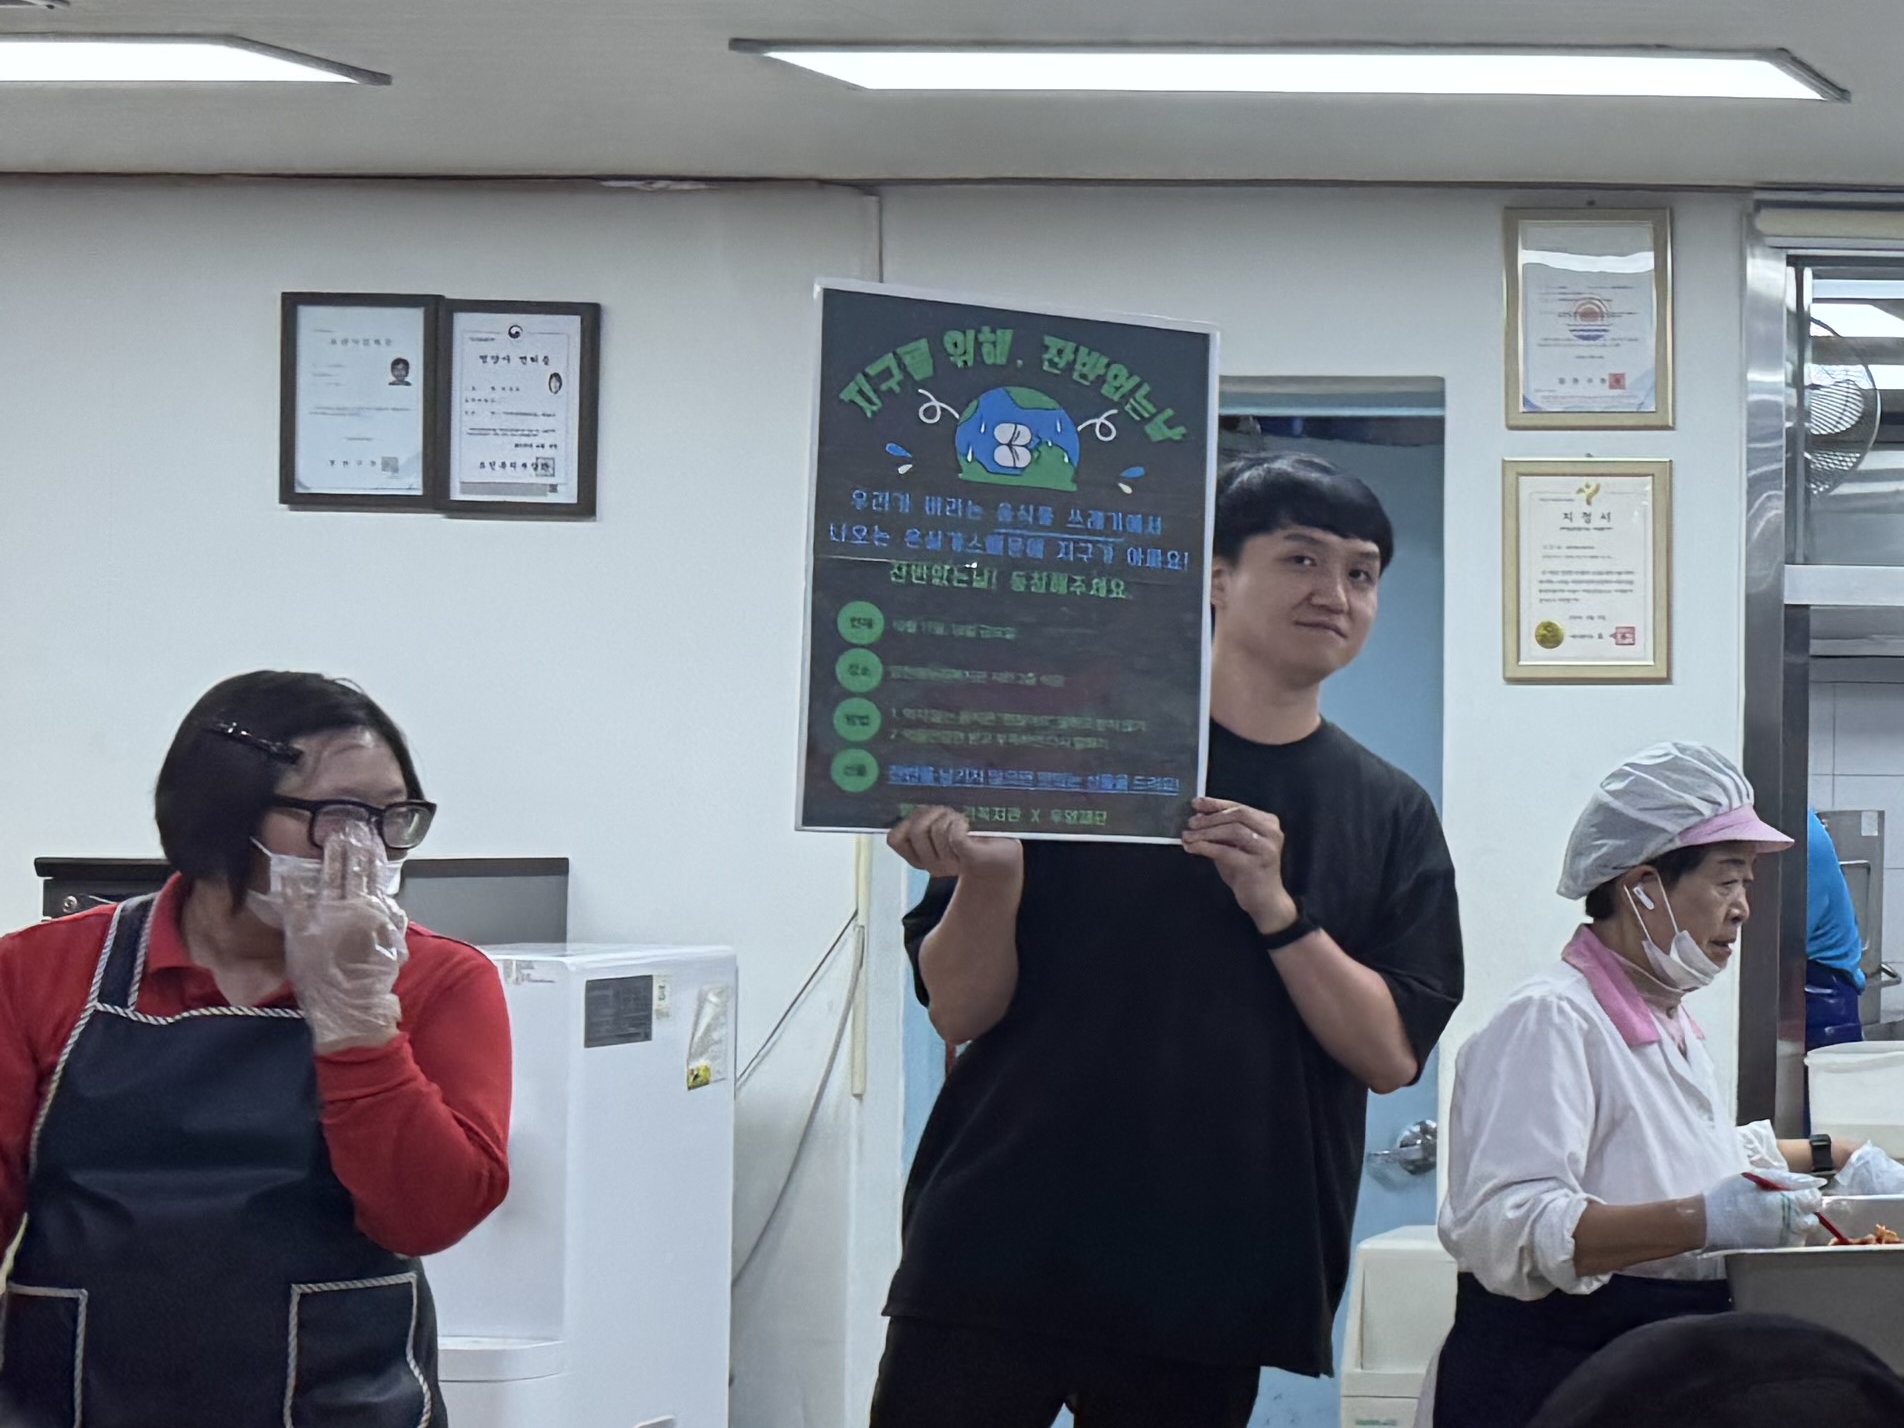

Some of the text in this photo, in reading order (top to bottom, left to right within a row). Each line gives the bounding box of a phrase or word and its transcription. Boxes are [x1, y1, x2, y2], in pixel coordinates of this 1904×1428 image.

[839, 338, 934, 419] 지구를
[852, 489, 911, 514] 우리가
[924, 495, 984, 520] 버리는
[830, 523, 890, 547] 나오는
[1057, 540, 1114, 564] 지구가
